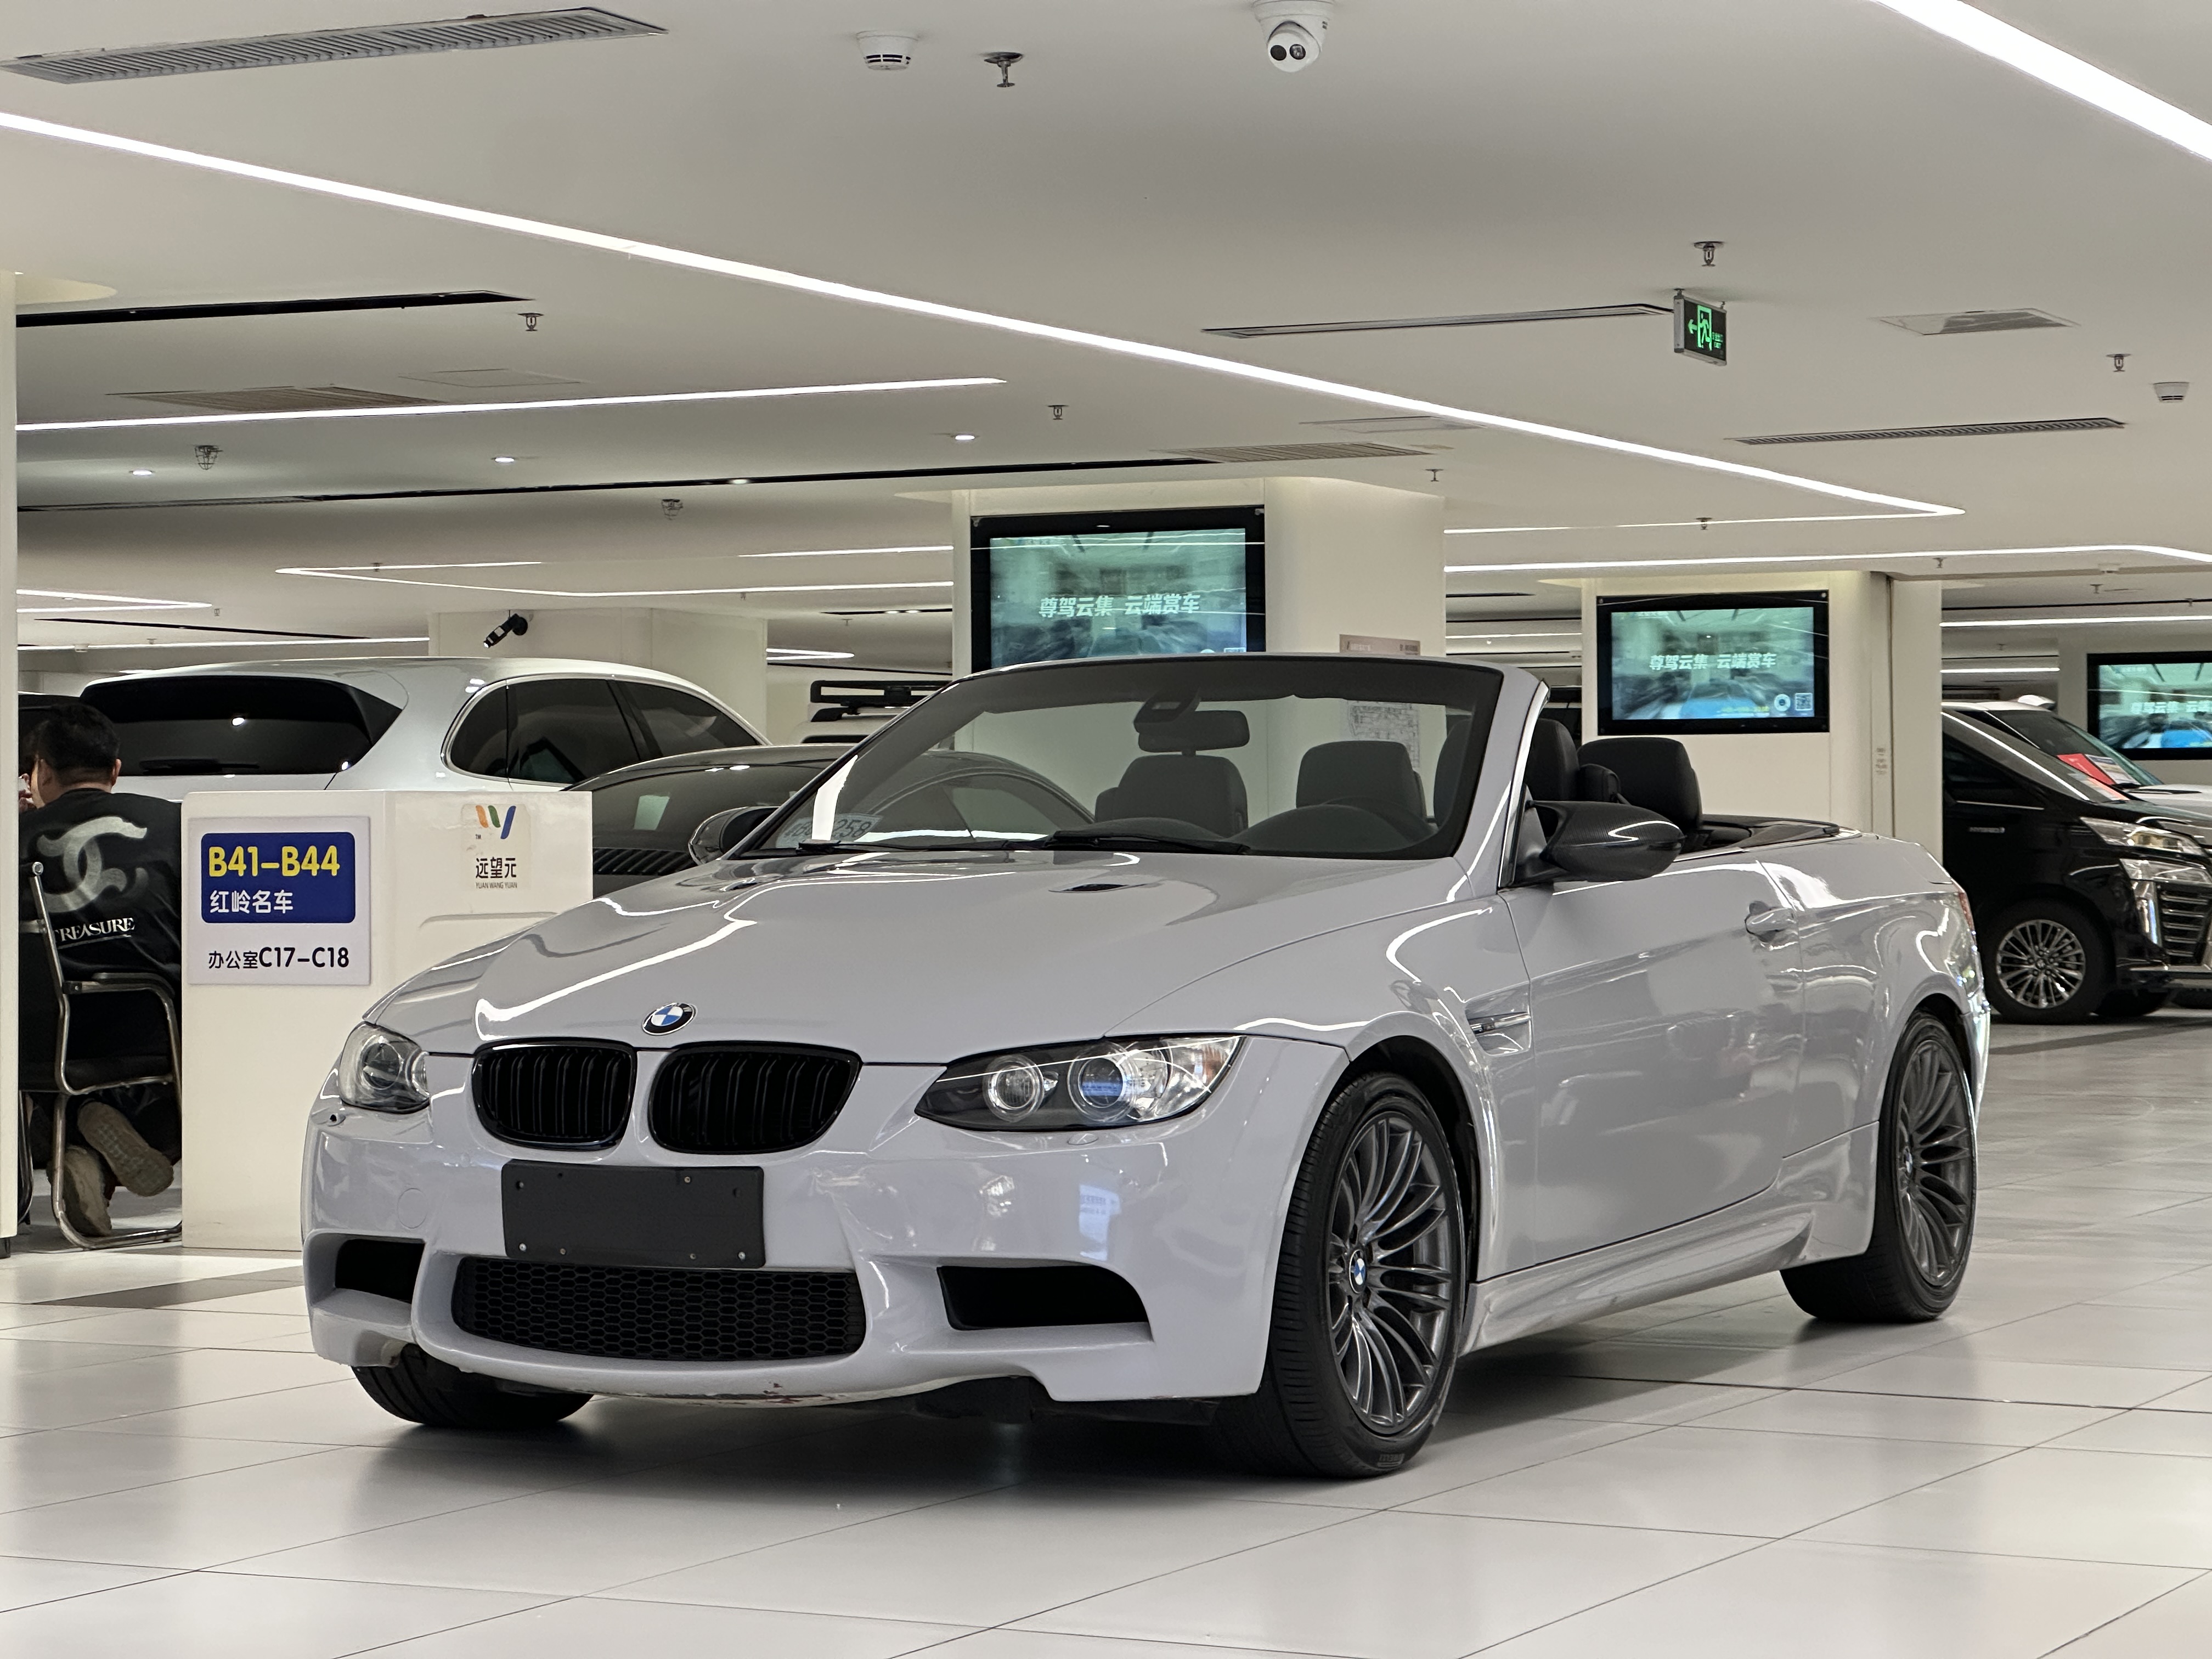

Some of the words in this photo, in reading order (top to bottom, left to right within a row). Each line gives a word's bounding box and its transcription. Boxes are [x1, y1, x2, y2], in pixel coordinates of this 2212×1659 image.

[1039, 595, 1114, 618] 尊驾云集
[1125, 594, 1200, 615] 云端赏车
[1650, 653, 1708, 670] 尊驾云集
[1717, 653, 1777, 669] 云端赏车
[209, 845, 340, 877] B41-B44
[476, 856, 517, 878] 远望元
[210, 890, 293, 913] 红岭名车
[55, 918, 136, 942] REASURE
[208, 947, 349, 969] 办公室C17-C18
